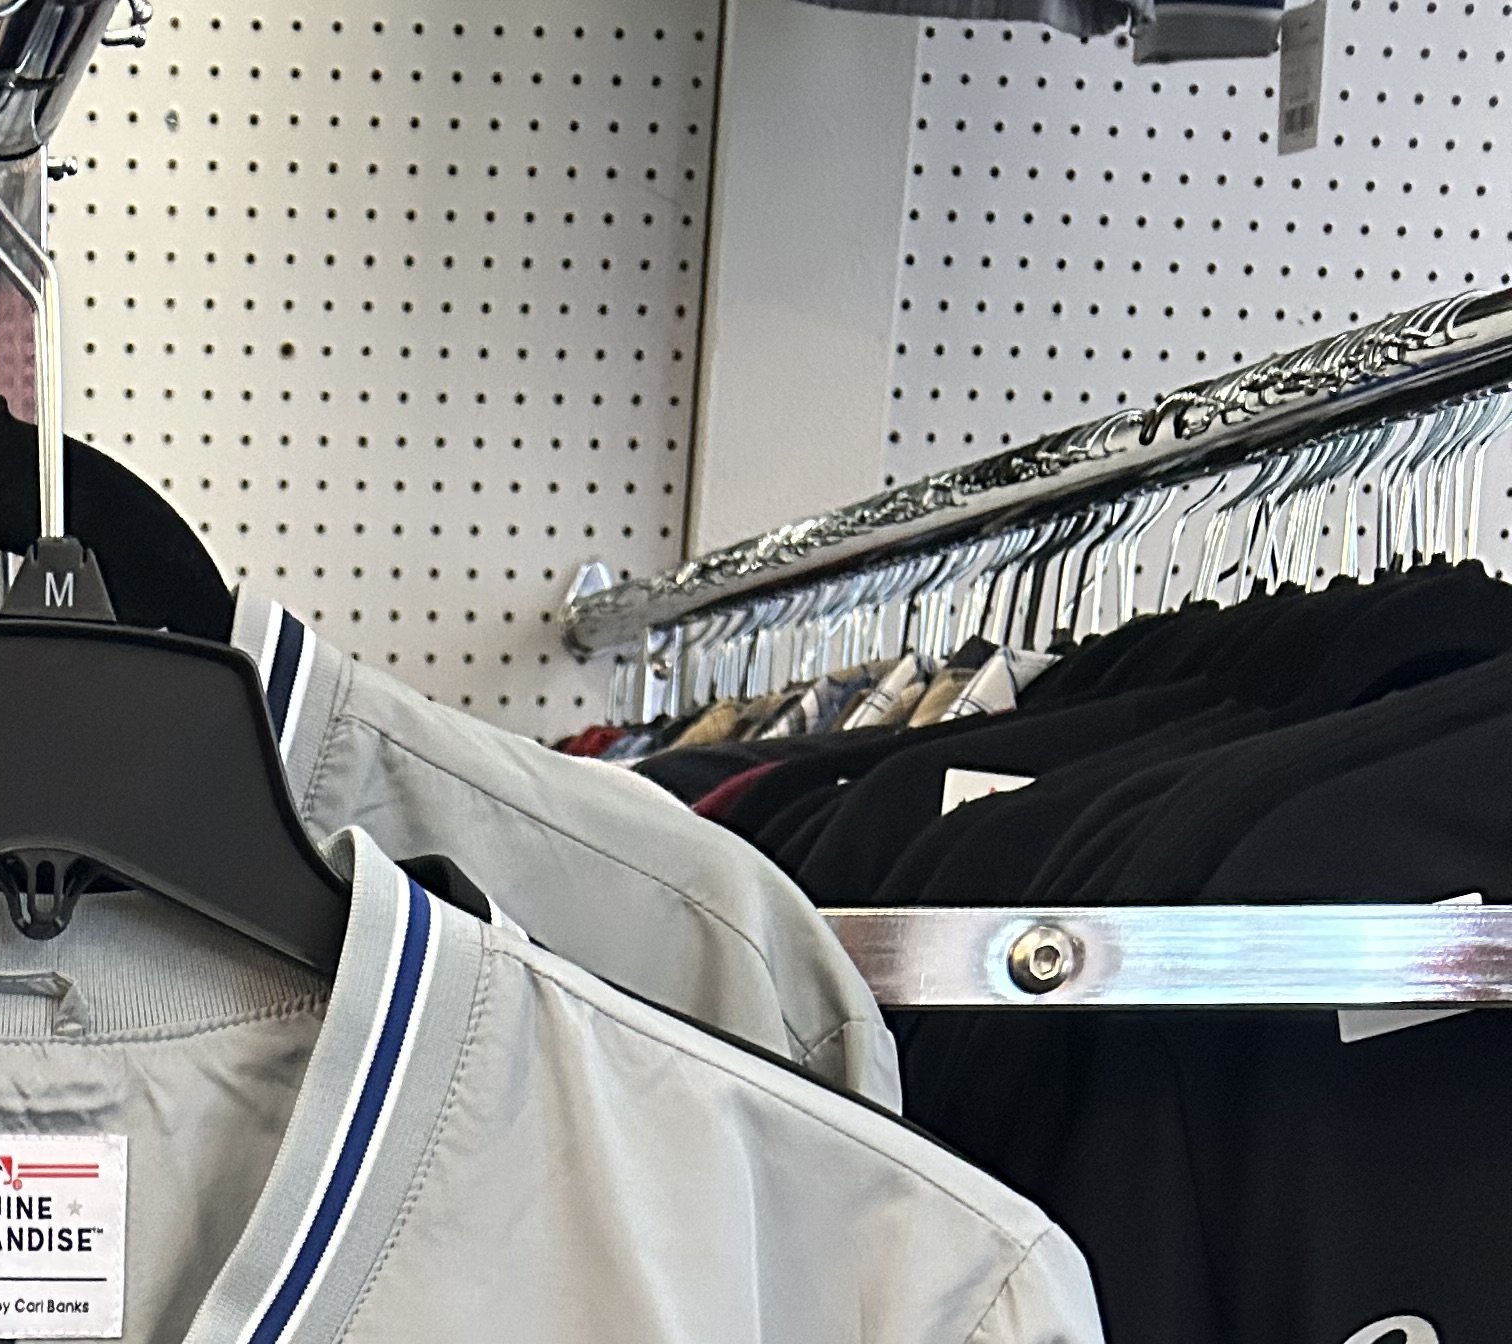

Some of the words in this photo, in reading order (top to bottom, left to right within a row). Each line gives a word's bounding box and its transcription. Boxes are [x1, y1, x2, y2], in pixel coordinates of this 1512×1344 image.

[45, 571, 74, 608] M
[14, 1298, 44, 1314] Carl
[46, 1298, 90, 1314] Banks
